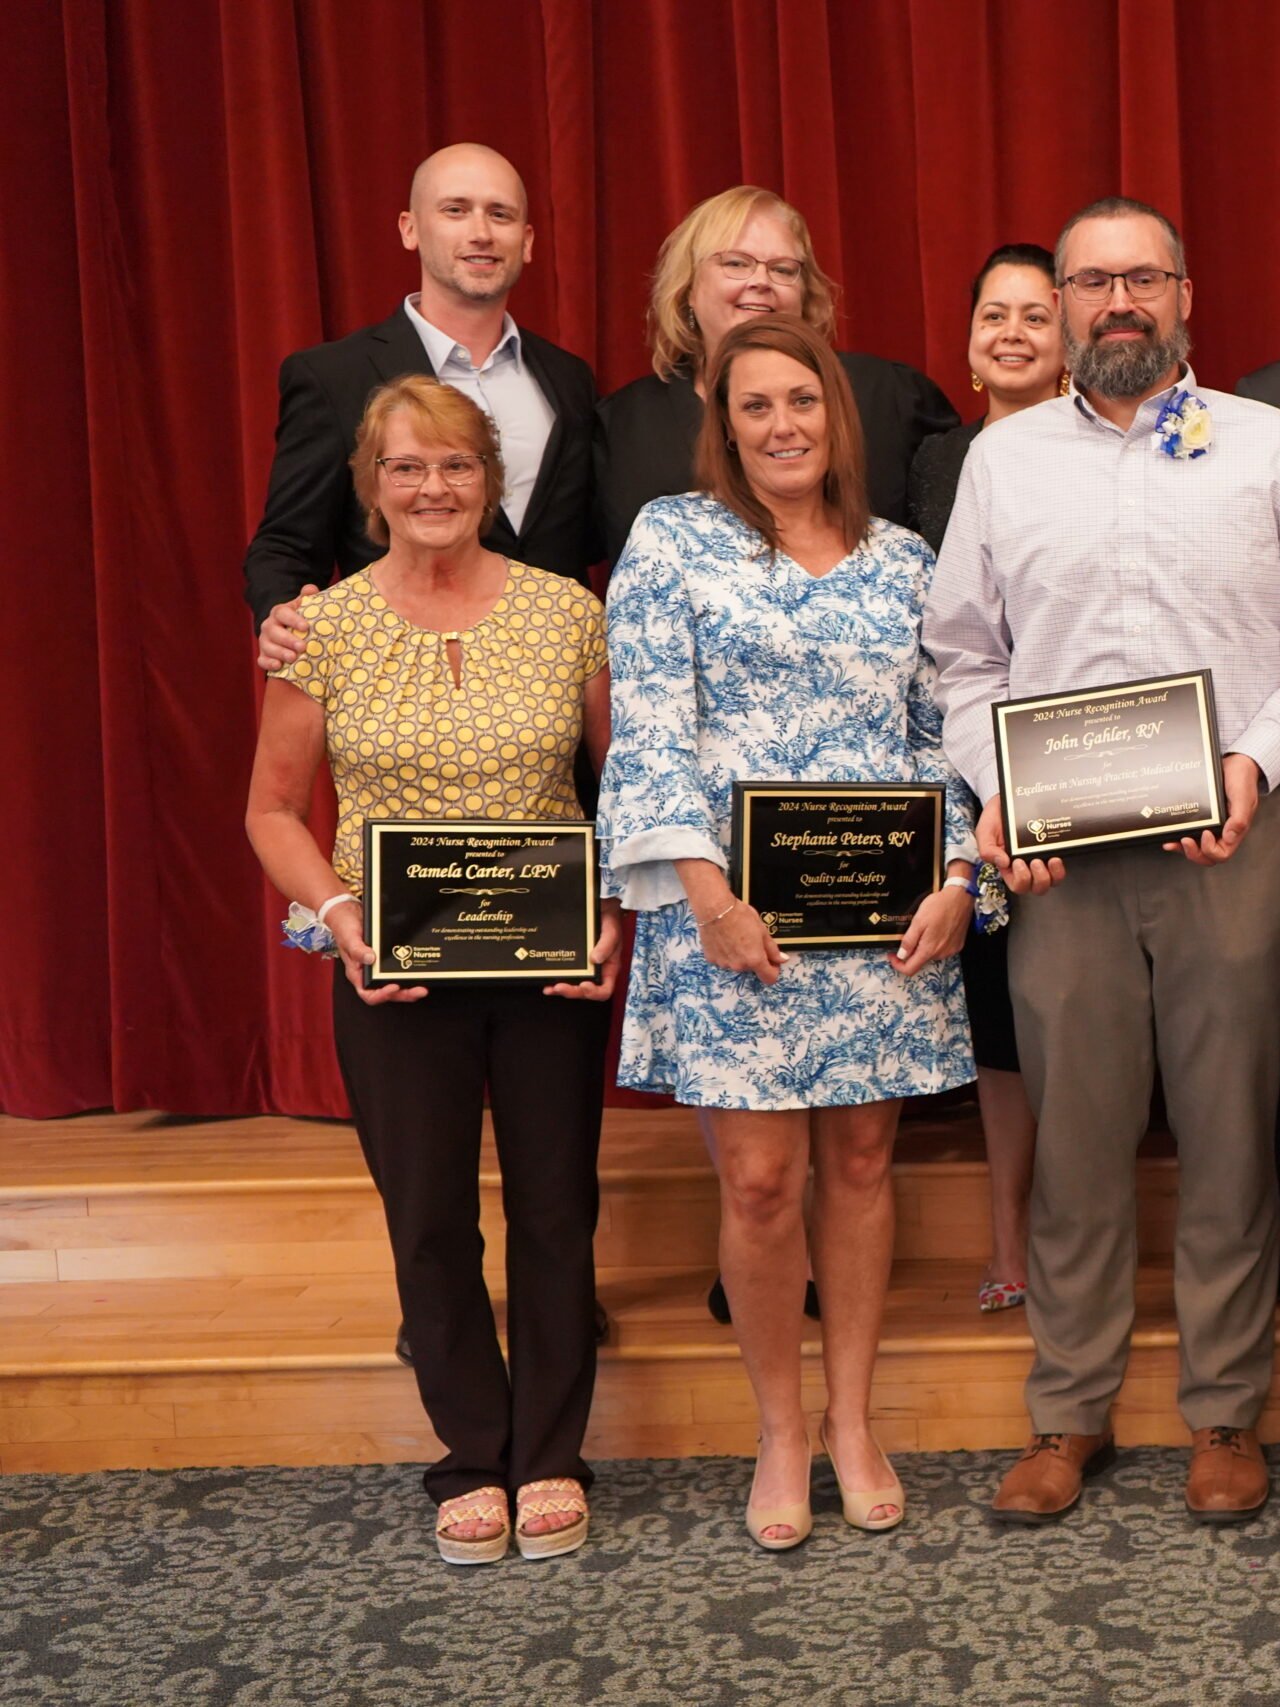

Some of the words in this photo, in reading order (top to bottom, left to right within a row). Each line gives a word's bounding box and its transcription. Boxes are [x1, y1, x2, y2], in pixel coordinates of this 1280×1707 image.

[1032, 710, 1054, 723] 2024
[1055, 707, 1083, 719] Nurse
[1084, 699, 1135, 715] Recognition
[1135, 691, 1169, 707] Award
[1084, 715, 1112, 727] presented
[1043, 734, 1079, 755] John
[1082, 727, 1132, 751] Gahler,
[1135, 720, 1165, 738] RN
[1102, 760, 1113, 770] for
[1015, 782, 1057, 797] Excellence
[1058, 780, 1068, 790] in
[1068, 775, 1102, 790] Nursing
[1139, 764, 1174, 777] Medical
[1174, 759, 1202, 772] Center
[778, 801, 799, 811] 2024
[800, 801, 827, 811] Nurse
[828, 801, 877, 813] Recognition
[877, 801, 910, 812] Award
[1153, 801, 1199, 814] Samaritan
[827, 815, 856, 824] presented
[1046, 821, 1072, 830] Nurses
[410, 836, 434, 847] 2024
[435, 837, 464, 847] Nurse
[465, 837, 521, 849] Recognition
[521, 837, 557, 847] Award
[770, 830, 837, 850] Stephanie
[840, 832, 884, 847] Peters,
[888, 831, 915, 846] RN
[464, 850, 497, 859] presented
[406, 862, 462, 879] Pamela
[465, 864, 515, 880] Carter,
[519, 864, 561, 879] LPN
[838, 861, 849, 870] for
[799, 874, 835, 887] Quality
[836, 873, 854, 883] and
[855, 872, 886, 885] Safety
[478, 899, 492, 909] for
[457, 911, 514, 924] Leadership
[529, 949, 576, 958] Samaritan
